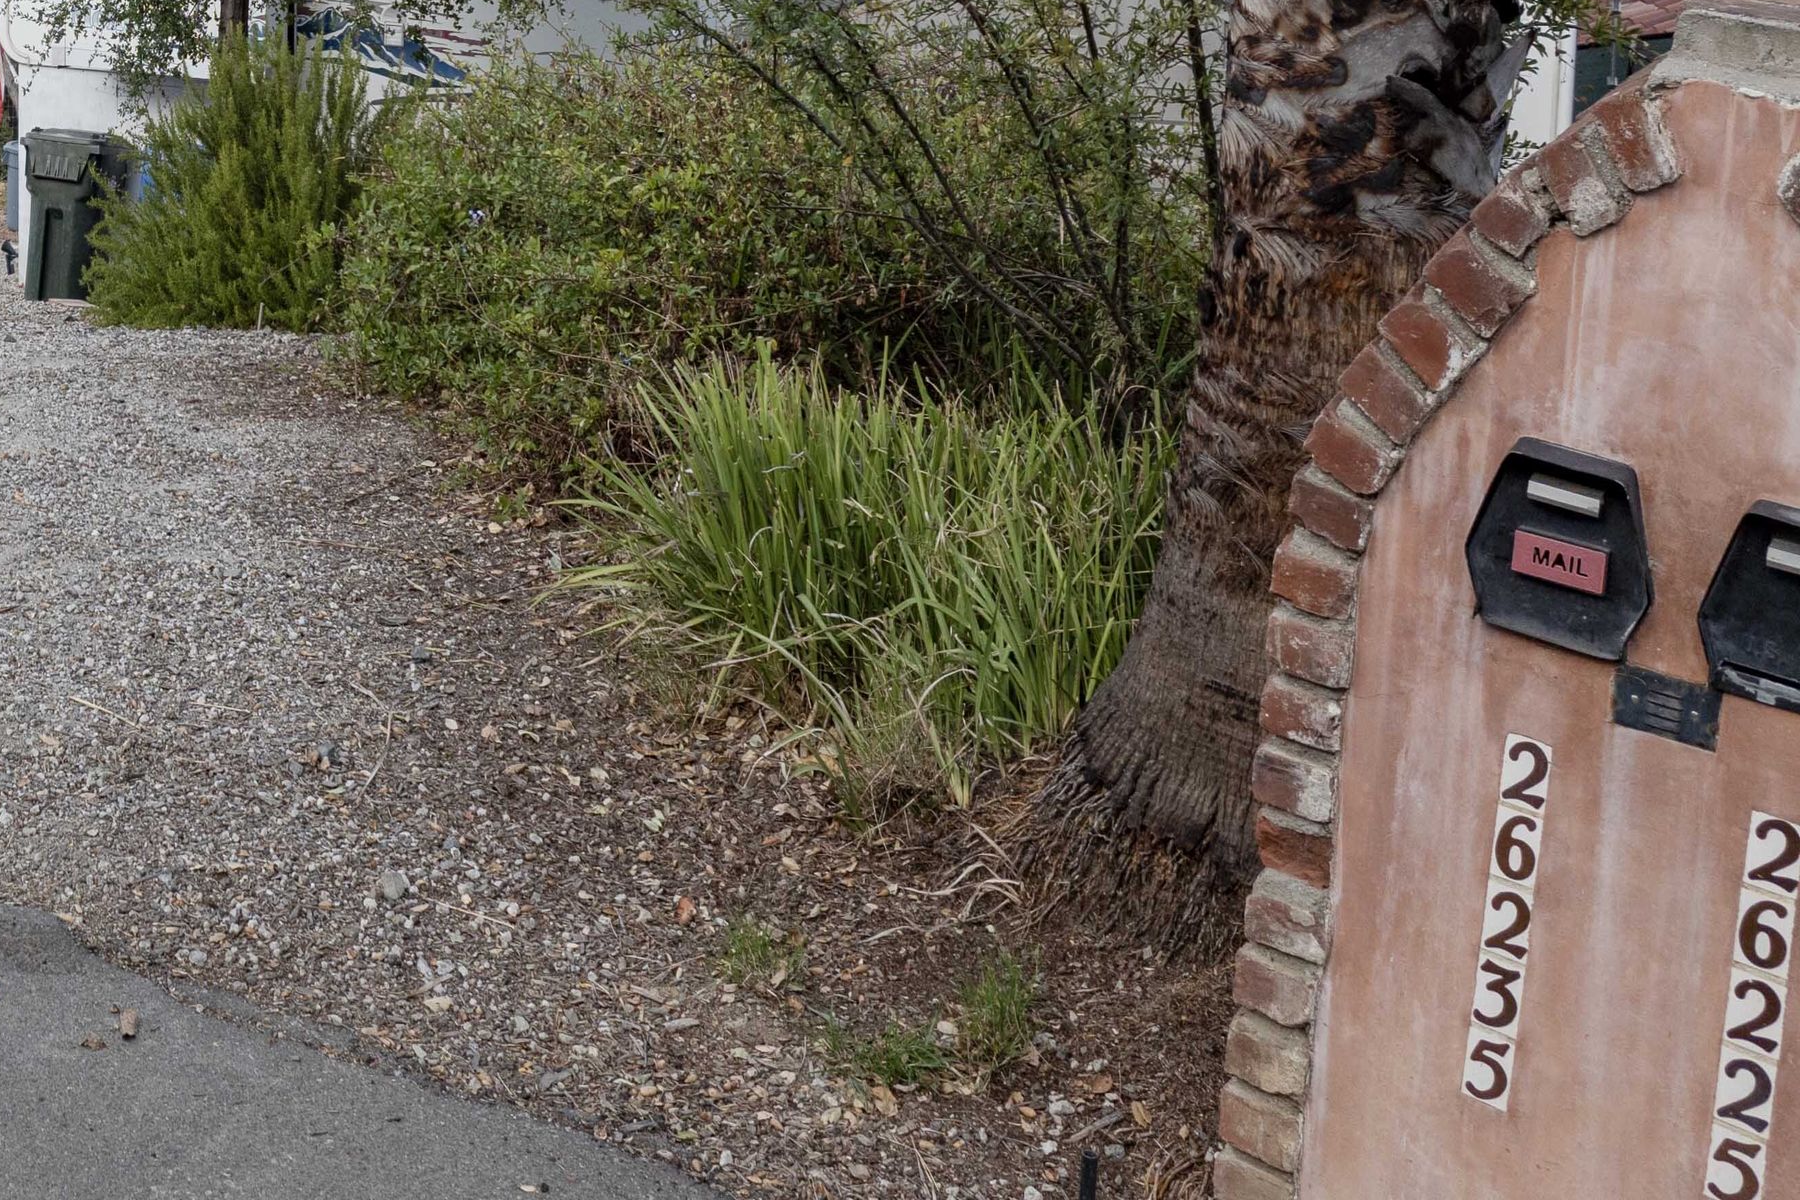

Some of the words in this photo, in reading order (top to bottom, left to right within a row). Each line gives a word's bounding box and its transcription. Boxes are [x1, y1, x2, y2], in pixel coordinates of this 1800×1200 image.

[1533, 547, 1588, 577] MAIL
[1465, 741, 1548, 1100] 26235
[1707, 819, 1800, 1200] 26225
